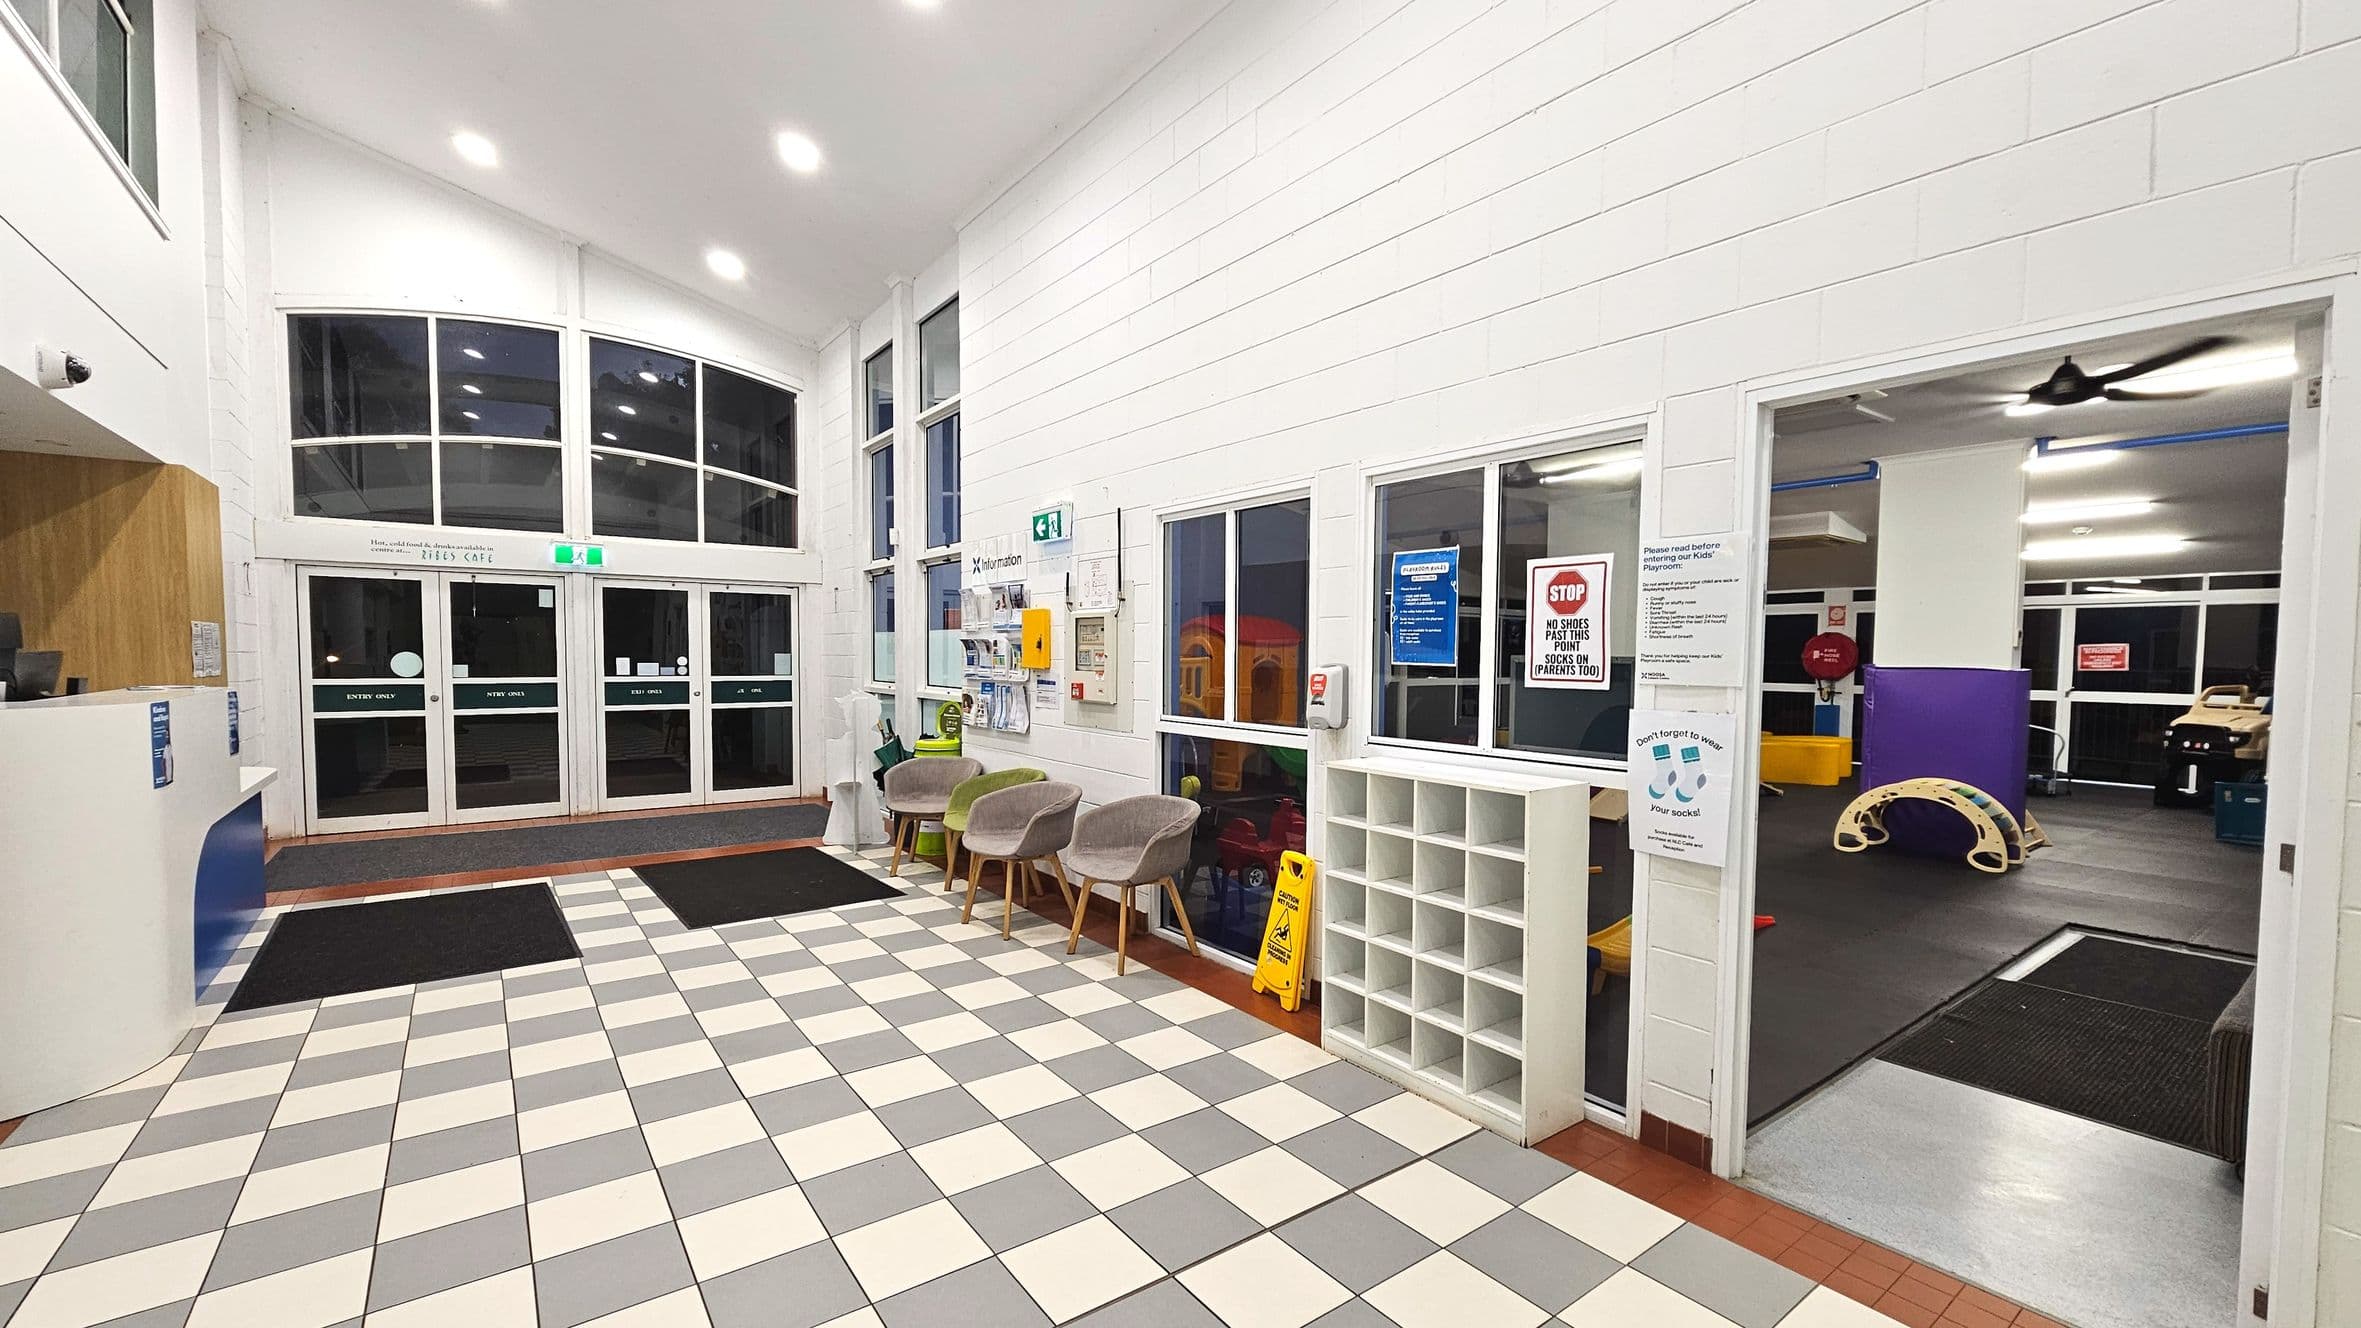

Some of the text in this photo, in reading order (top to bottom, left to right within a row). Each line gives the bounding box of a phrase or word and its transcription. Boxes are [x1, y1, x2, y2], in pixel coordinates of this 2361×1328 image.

[1643, 542, 1721, 554] Please read before
[982, 554, 1022, 571] Information
[1643, 550, 1715, 563] entering our Kids'
[1643, 562, 1683, 573] Playroom:
[1549, 583, 1585, 602] STOP
[1546, 618, 1589, 630] NO SHOES
[1545, 630, 1590, 641] PAST THIS
[1554, 641, 1580, 652] POINT
[1545, 654, 1589, 665] SOCKS ON
[1534, 665, 1600, 678] (PARENTS TOO)
[1635, 729, 1723, 752] Don't forget to wear
[1650, 804, 1701, 817] your socks!
[1279, 890, 1299, 905] CAUTION
[1277, 898, 1299, 912] WET FLOOR
[1267, 942, 1291, 960] CLEANING IN
[1267, 949, 1288, 966] PROGRESS
